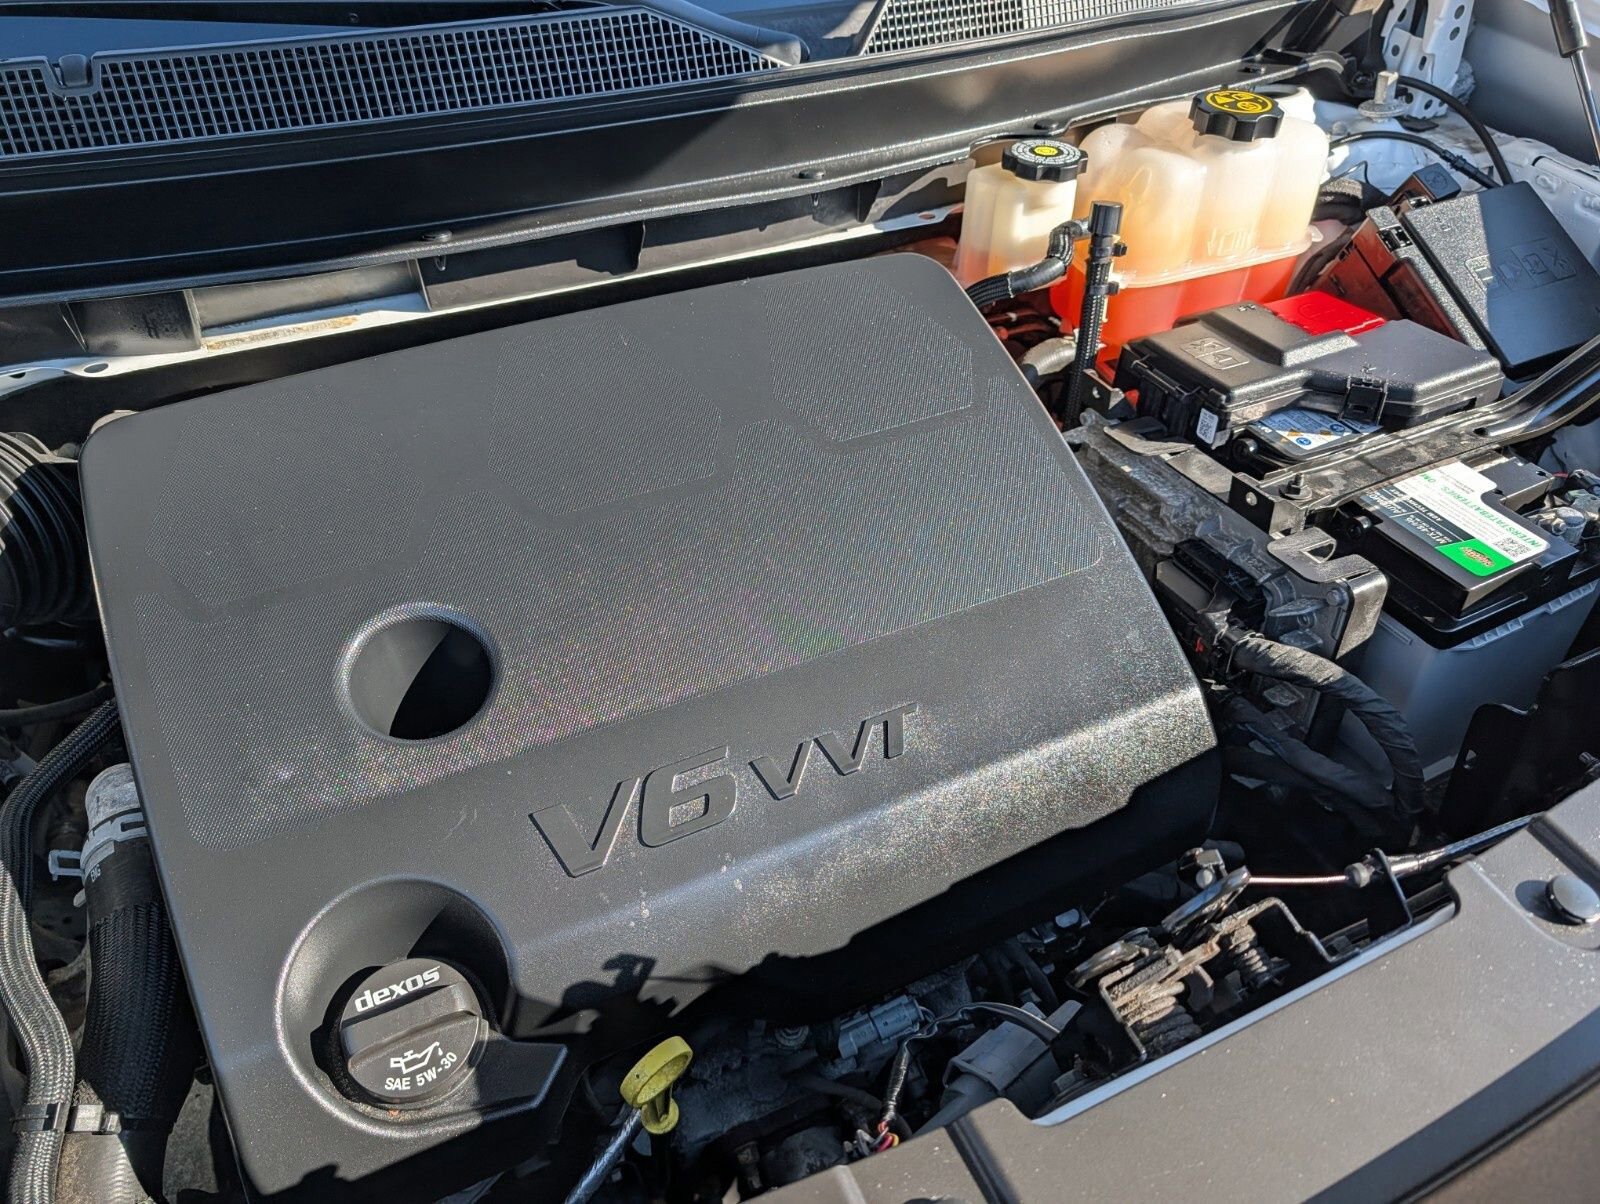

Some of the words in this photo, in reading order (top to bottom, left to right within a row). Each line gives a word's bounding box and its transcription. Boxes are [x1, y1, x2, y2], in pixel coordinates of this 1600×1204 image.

[528, 745, 738, 878] V6
[748, 702, 918, 800] VVT
[354, 965, 441, 1012] dexos
[384, 1077, 411, 1091] SAE
[416, 1051, 458, 1087] 5W-30
